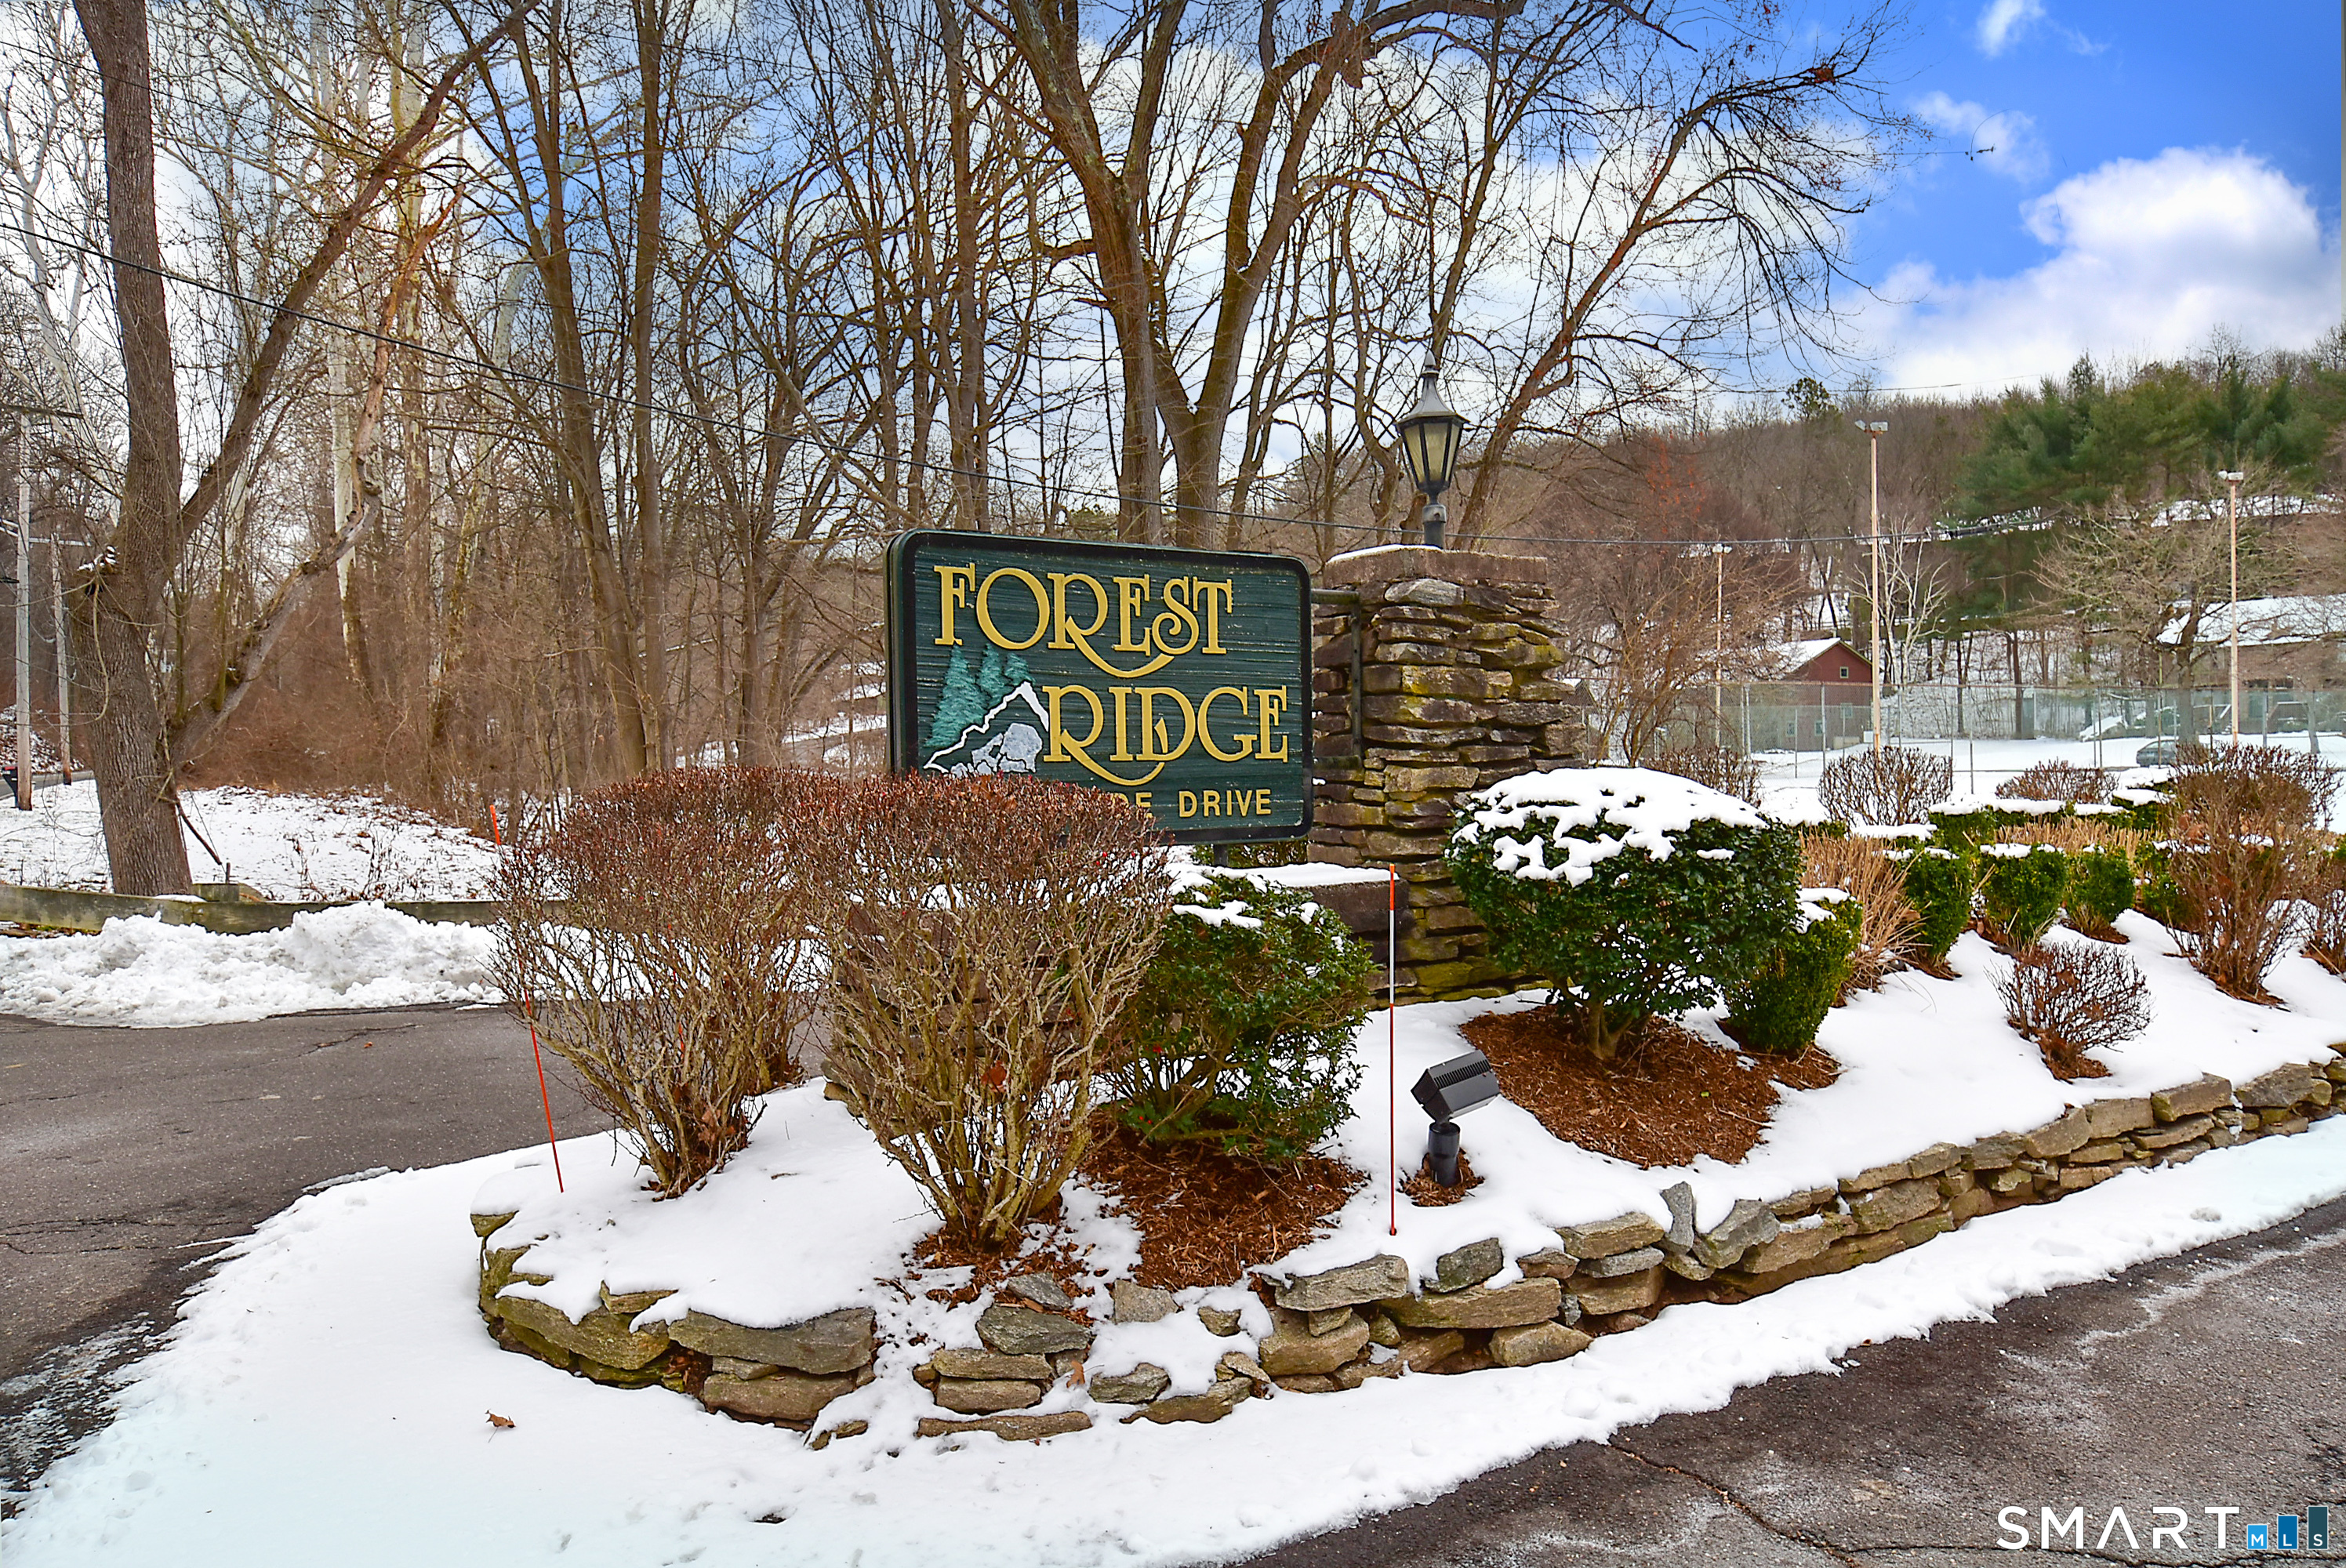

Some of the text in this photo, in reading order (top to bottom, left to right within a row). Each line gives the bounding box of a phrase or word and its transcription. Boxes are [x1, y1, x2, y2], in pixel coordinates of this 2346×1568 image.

[934, 562, 1233, 677] FOREST
[1042, 685, 1287, 786] RIDGE
[1178, 789, 1272, 818] DRIVE
